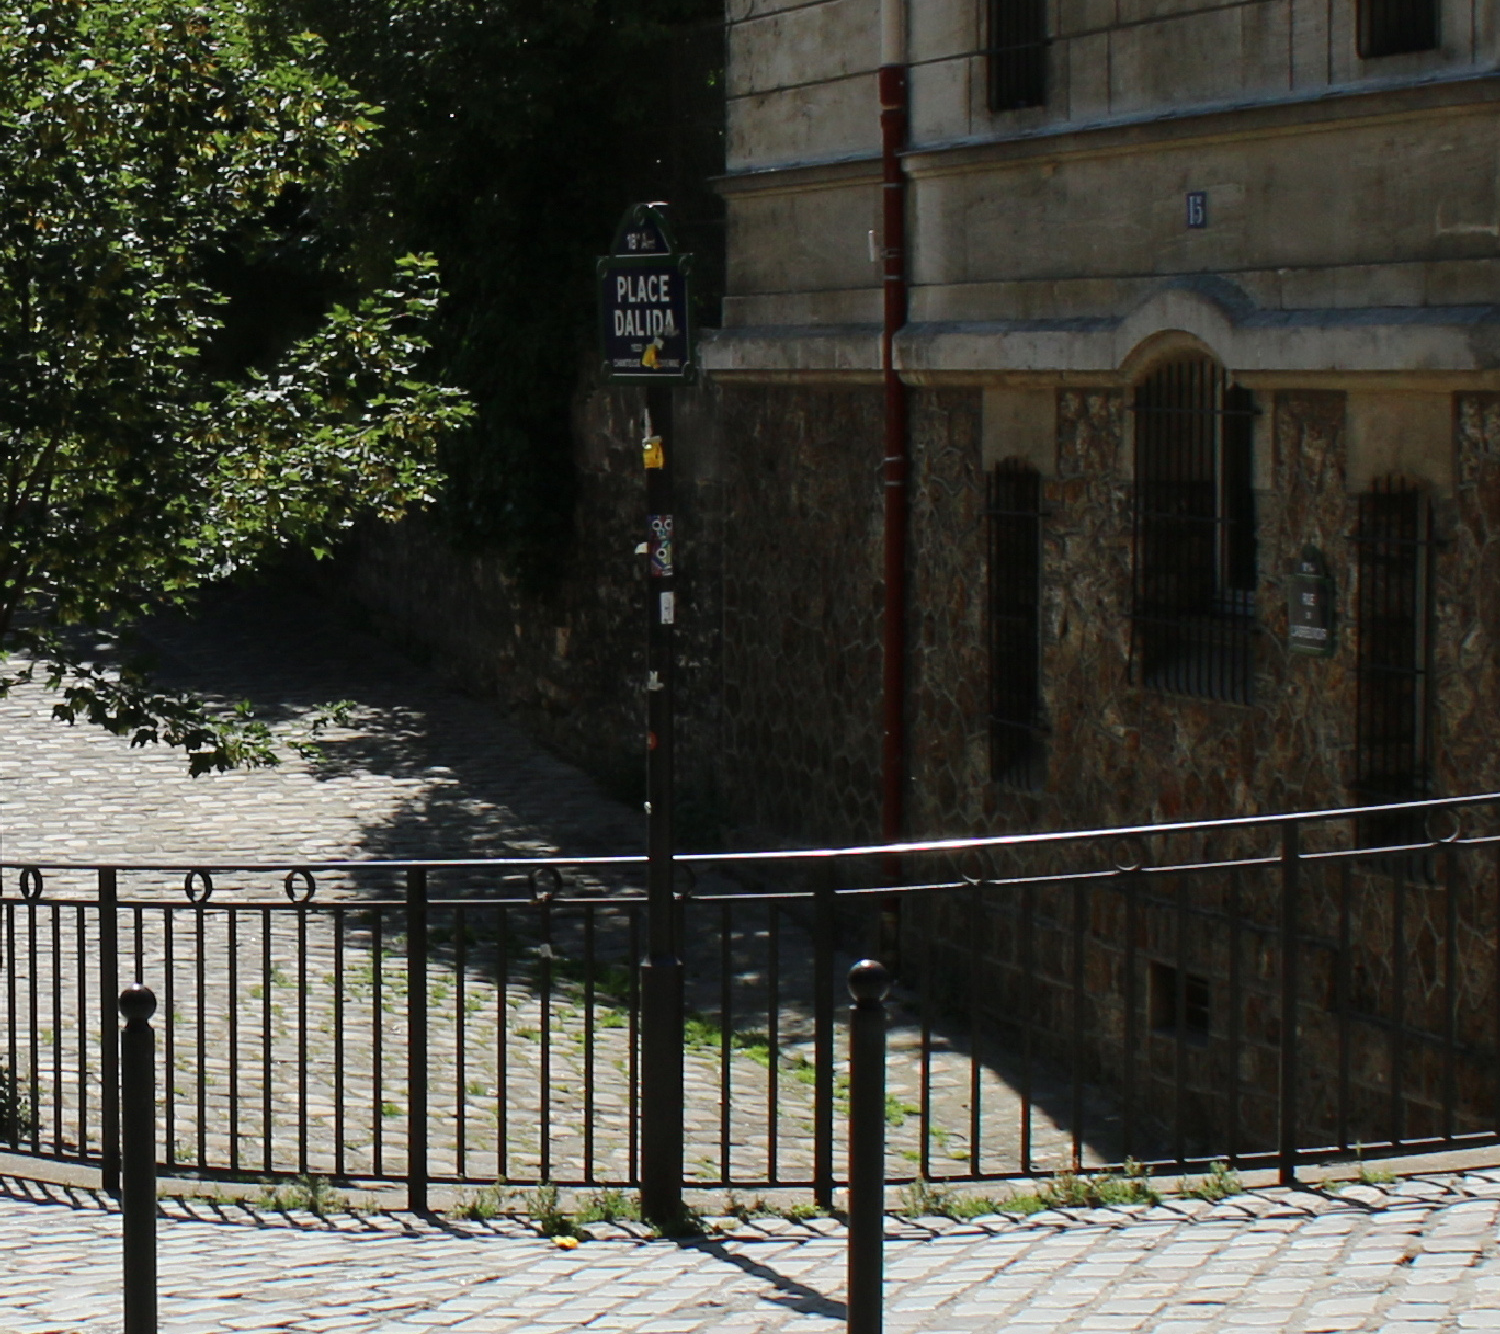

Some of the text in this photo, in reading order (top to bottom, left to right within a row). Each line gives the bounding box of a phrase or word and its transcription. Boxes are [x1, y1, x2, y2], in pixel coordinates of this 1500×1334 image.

[1189, 195, 1203, 224] 15
[616, 275, 671, 303] PLACE
[613, 308, 676, 336] DALIDA
